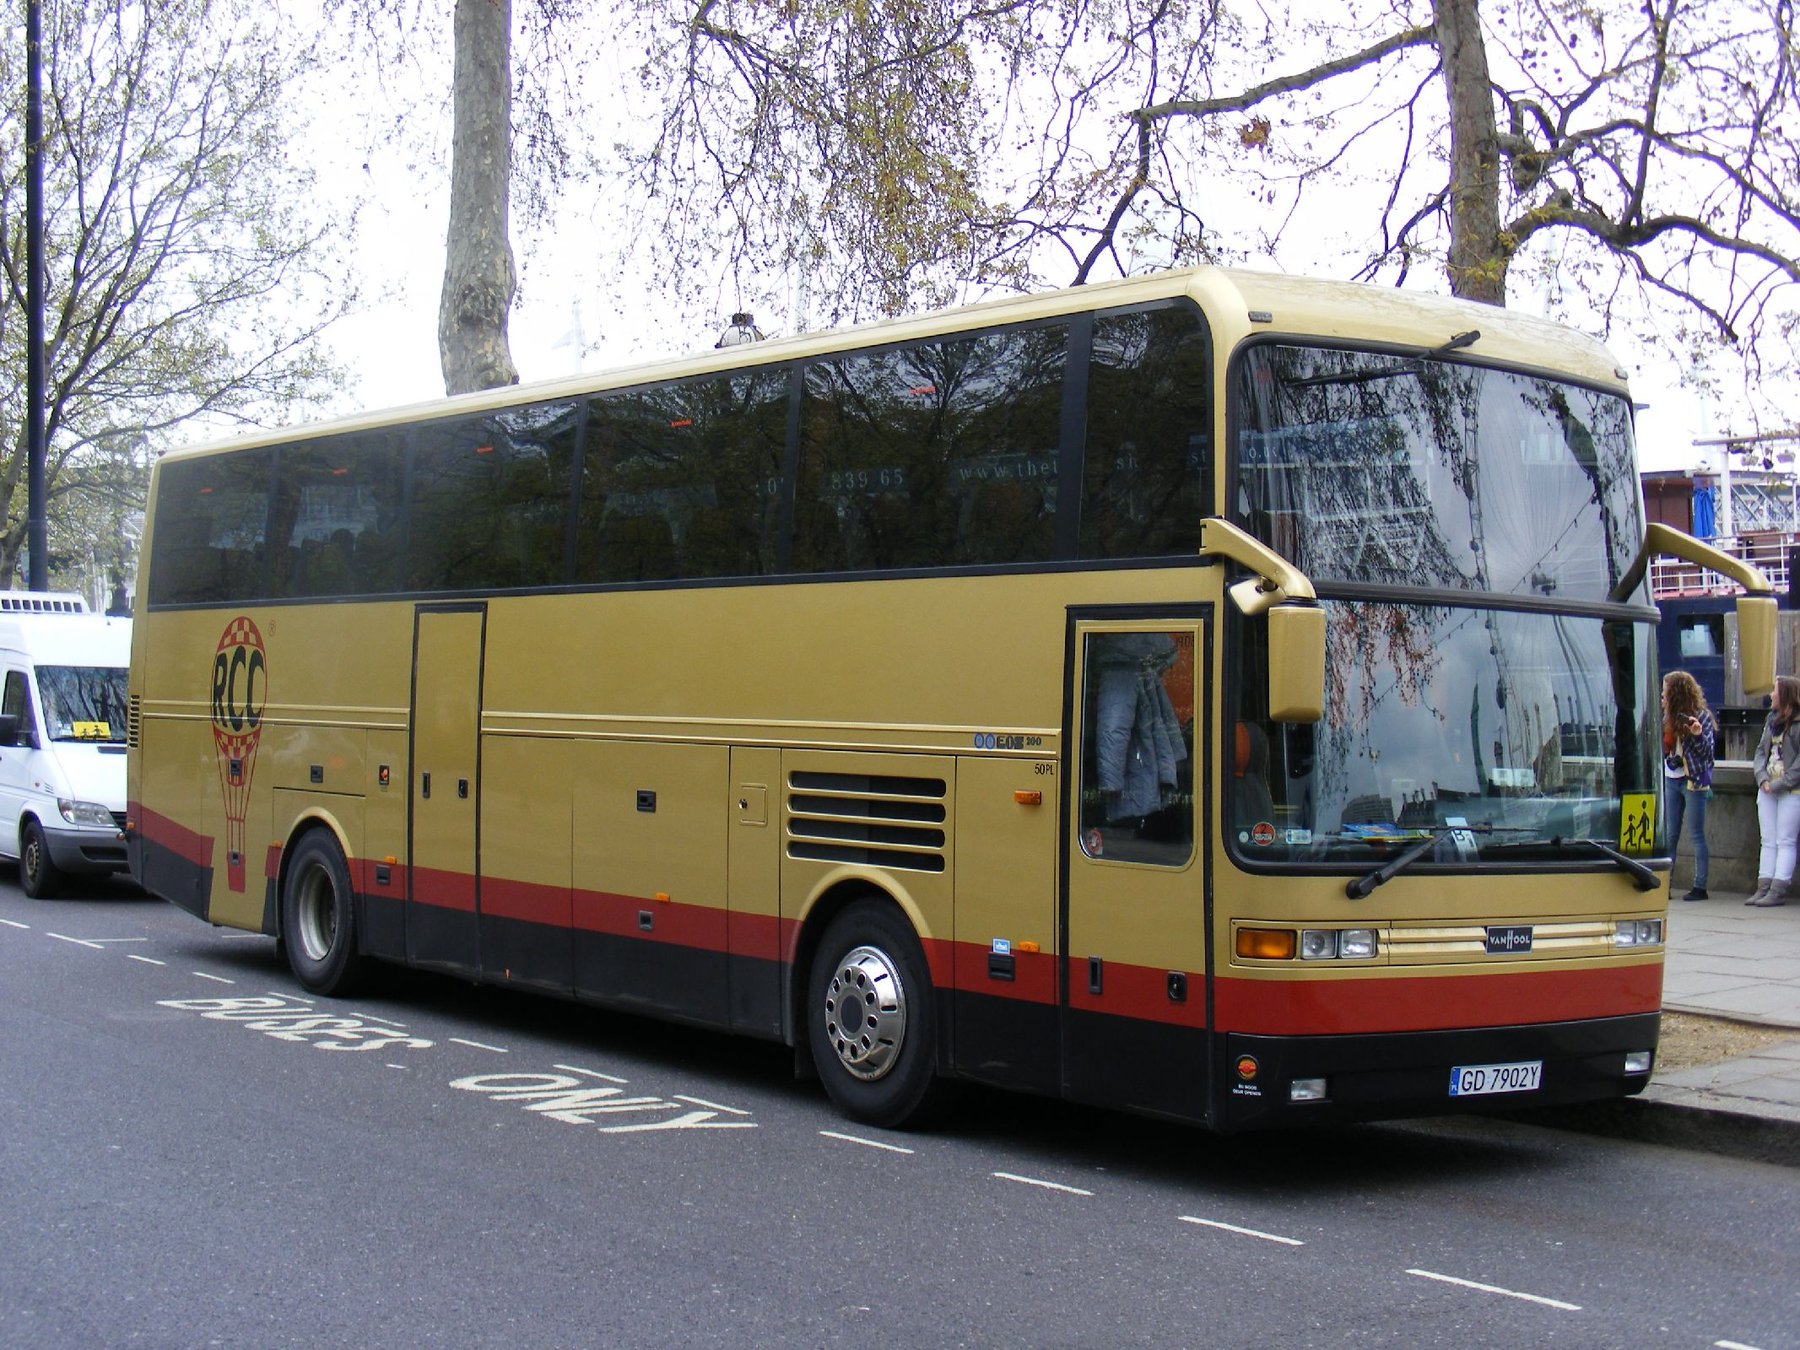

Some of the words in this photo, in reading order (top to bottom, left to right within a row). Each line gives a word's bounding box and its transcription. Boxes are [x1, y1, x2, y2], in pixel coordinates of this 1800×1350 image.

[213, 645, 264, 732] RCC
[155, 997, 435, 1052] BUSES
[449, 1073, 759, 1133] ONLY
[1461, 1070, 1486, 1092] GD
[1490, 1066, 1538, 1090] 7902Y
